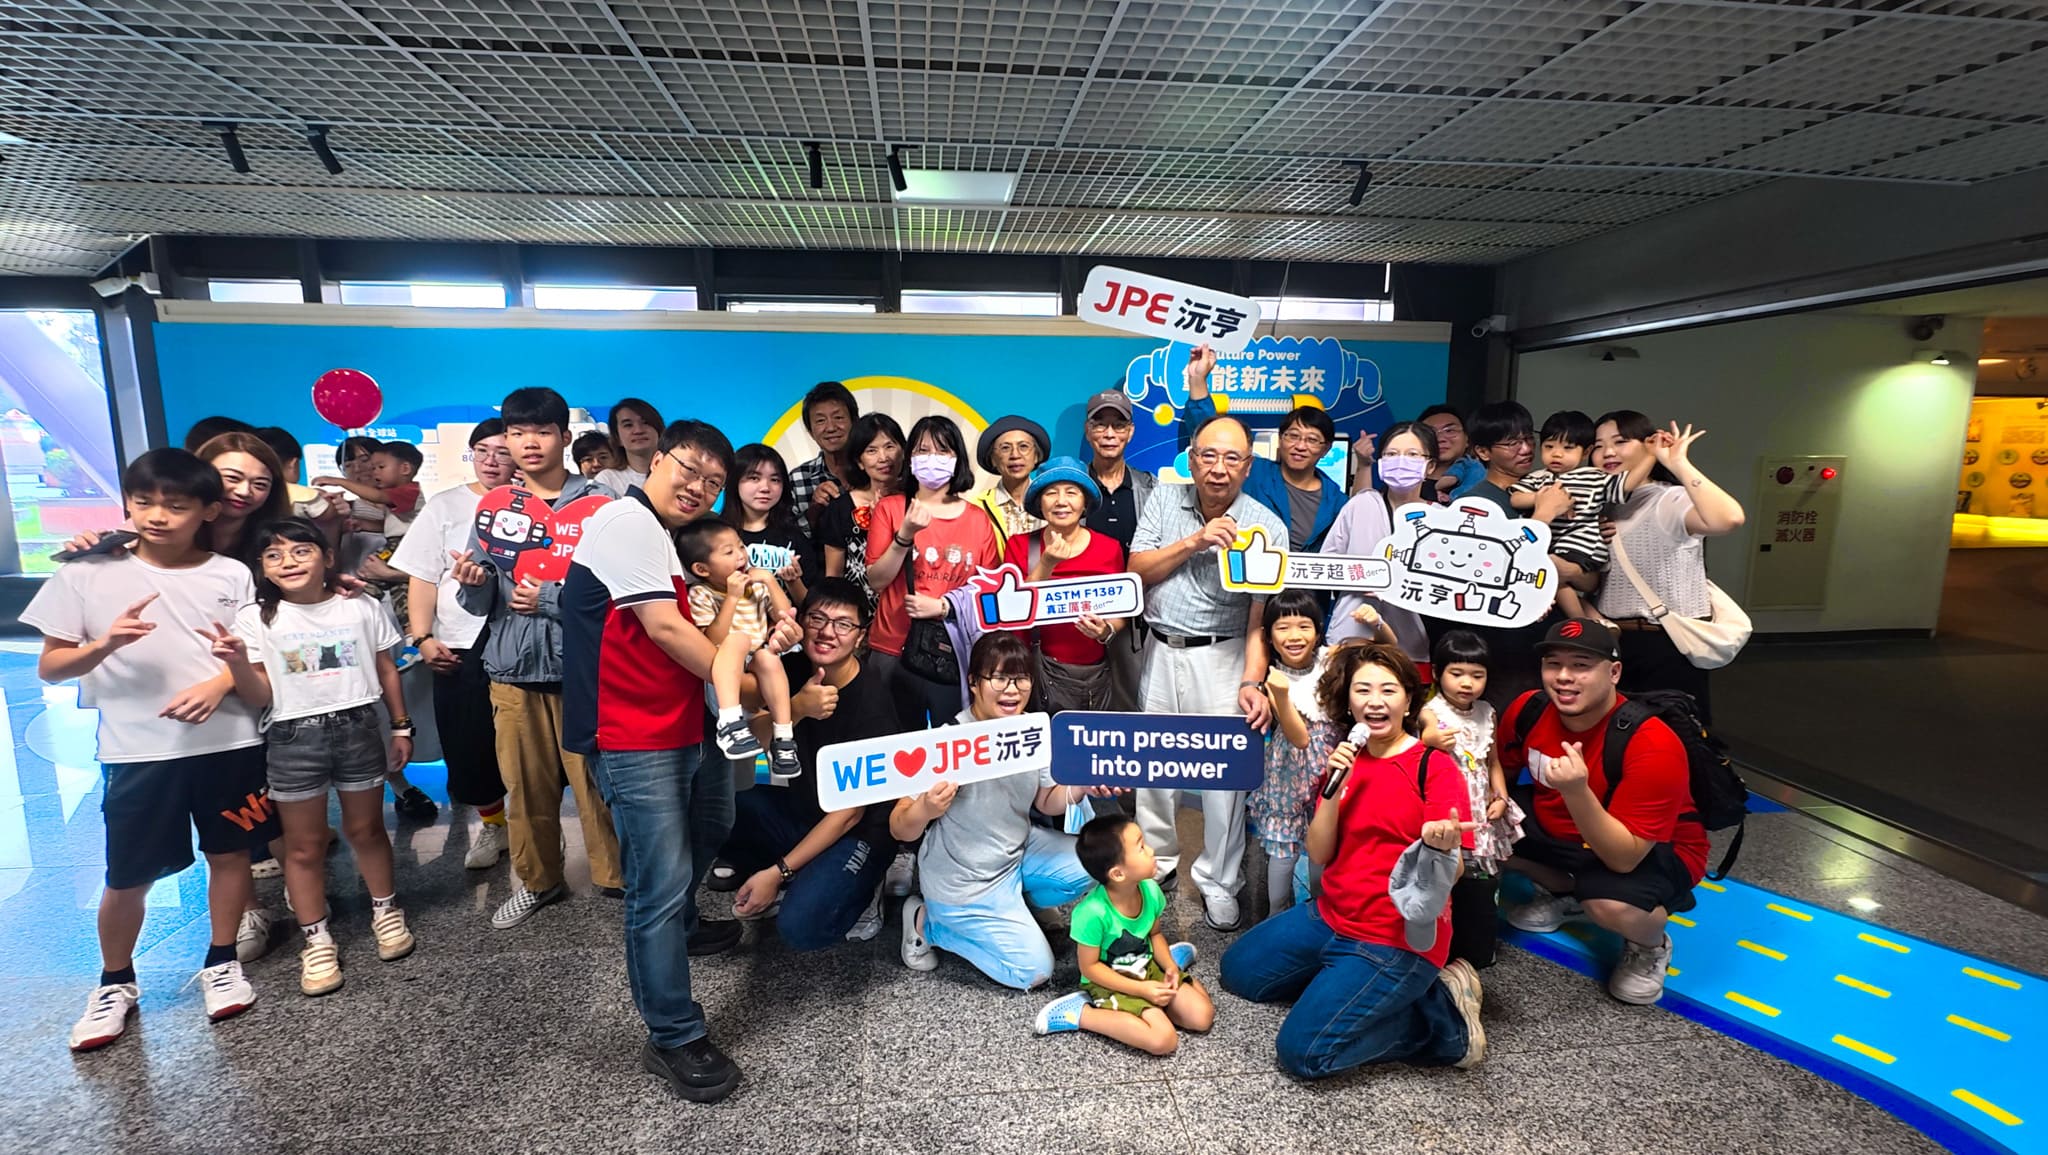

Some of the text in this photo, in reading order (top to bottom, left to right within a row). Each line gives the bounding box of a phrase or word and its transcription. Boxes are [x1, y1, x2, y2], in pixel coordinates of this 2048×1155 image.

[1094, 281, 1247, 338] JPE 沅亨
[1215, 349, 1300, 361] uture Power
[1182, 365, 1326, 392] 能新未來
[1777, 511, 1817, 525] 消防栓
[555, 522, 579, 537] WE
[1776, 528, 1815, 542] 滅火器
[552, 543, 574, 557] JP
[1045, 586, 1123, 602] ASTM F1387
[1400, 579, 1453, 605] 沅亨
[1068, 725, 1248, 752] Turn pressure
[832, 727, 1043, 792] WE JPE 沅亨
[1091, 754, 1228, 782] into power
